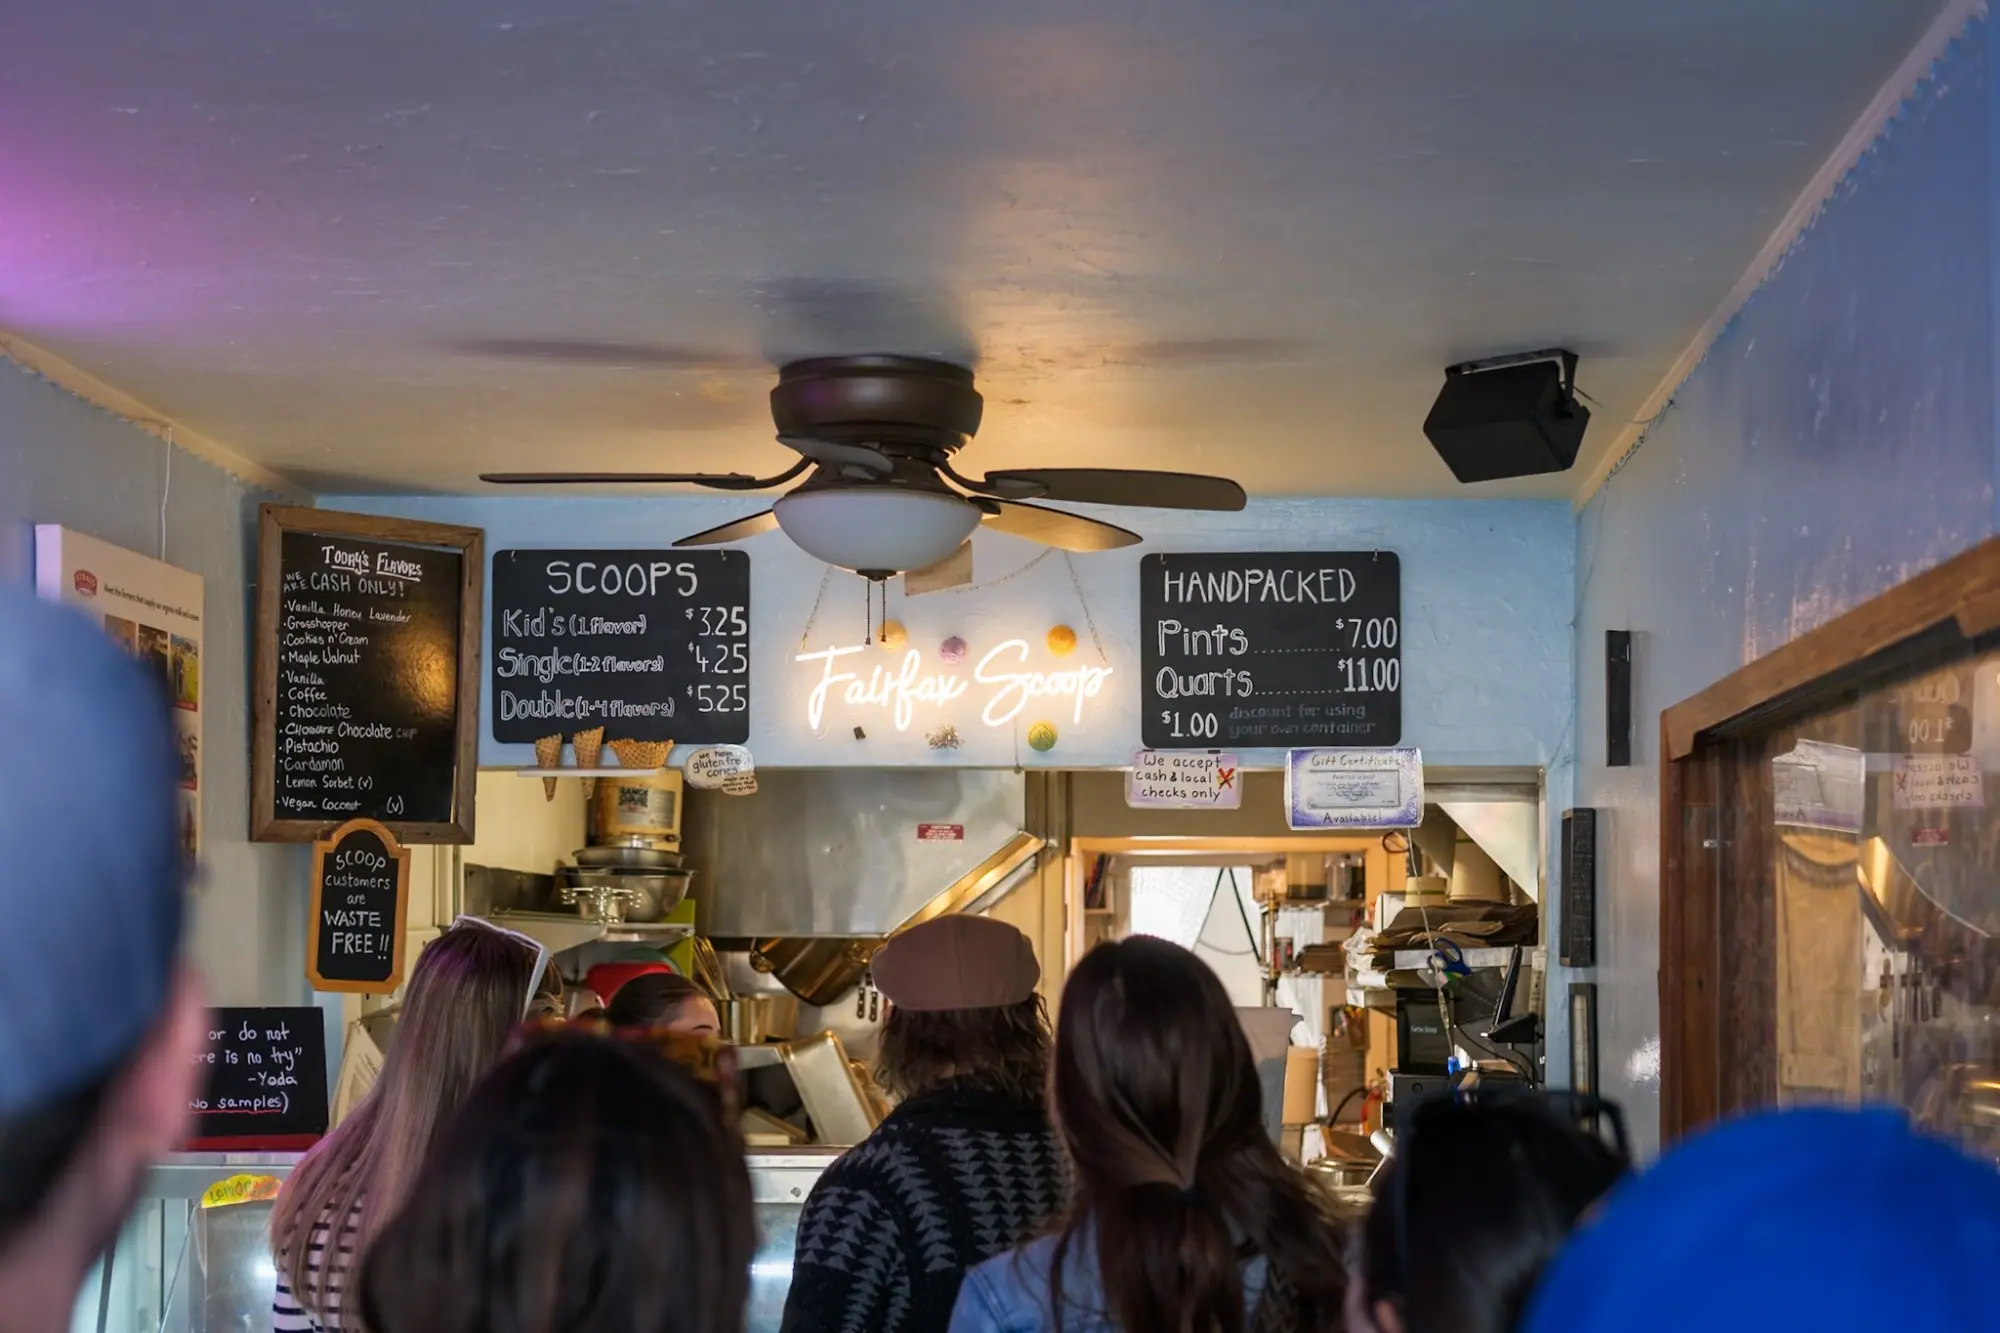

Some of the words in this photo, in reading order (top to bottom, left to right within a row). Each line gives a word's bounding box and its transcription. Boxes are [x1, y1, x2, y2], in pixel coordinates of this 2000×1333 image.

[285, 572, 302, 581] WE
[311, 572, 351, 593] CASH
[546, 560, 698, 597] SCOOPS
[284, 580, 308, 593] ARE
[1164, 568, 1356, 604] HANDPACKED
[287, 600, 325, 614] Vanilla
[333, 603, 362, 620] Honey
[369, 607, 412, 623] Lavender
[287, 616, 349, 632] Grasshopper
[502, 607, 566, 637] Kid's
[590, 614, 648, 636] flavor)
[685, 606, 747, 636] $3.25
[286, 632, 324, 647] Cookies
[339, 632, 369, 645] Cream
[1157, 619, 1249, 656] Pints
[1335, 616, 1398, 649] $7.00
[288, 651, 320, 668] Maple
[322, 647, 361, 664] Walnut
[497, 646, 574, 684] Single
[573, 652, 601, 676] (1-2
[602, 655, 665, 673] flavors)
[688, 642, 747, 674] $4.25
[286, 670, 324, 686] Vanilla
[795, 645, 969, 731] Fairfax
[974, 639, 1113, 727] Scoop
[1156, 666, 1254, 699] Quarts
[1337, 657, 1400, 693] $11.00
[288, 687, 327, 704] Coffee
[500, 689, 575, 721] Double
[575, 696, 608, 719] (1-4
[608, 696, 676, 718] flavors)
[686, 684, 747, 713] $5.25
[289, 703, 353, 719] Chocolate
[1161, 710, 1218, 738] $1.00
[1229, 704, 1292, 719] discount
[1298, 704, 1320, 719] for
[1325, 704, 1366, 719] using
[338, 722, 392, 739] Chocolate
[1229, 723, 1267, 739] your
[1270, 724, 1299, 735] own
[1303, 721, 1376, 735] container
[285, 738, 339, 753] Pistachio
[693, 759, 725, 774] gluten
[1144, 755, 1166, 768] We
[1173, 755, 1222, 771] accept
[1312, 754, 1336, 766] Gift
[285, 775, 317, 788] Lemon
[323, 774, 354, 789] Sorbet
[1136, 770, 1167, 782] cash
[1181, 771, 1212, 784] local
[1141, 786, 1187, 798] checks
[1191, 786, 1221, 803] only
[282, 796, 317, 811] Vegan
[336, 850, 386, 872] SCOOP
[325, 873, 390, 890] customers
[347, 893, 366, 905] are
[324, 910, 381, 927] WASTE
[332, 932, 373, 954] FREE
[208, 1029, 227, 1041] or
[238, 1021, 258, 1041] do
[266, 1022, 290, 1041] not
[225, 1050, 239, 1064] is
[247, 1053, 262, 1064] no
[218, 1091, 289, 1114] samples)
